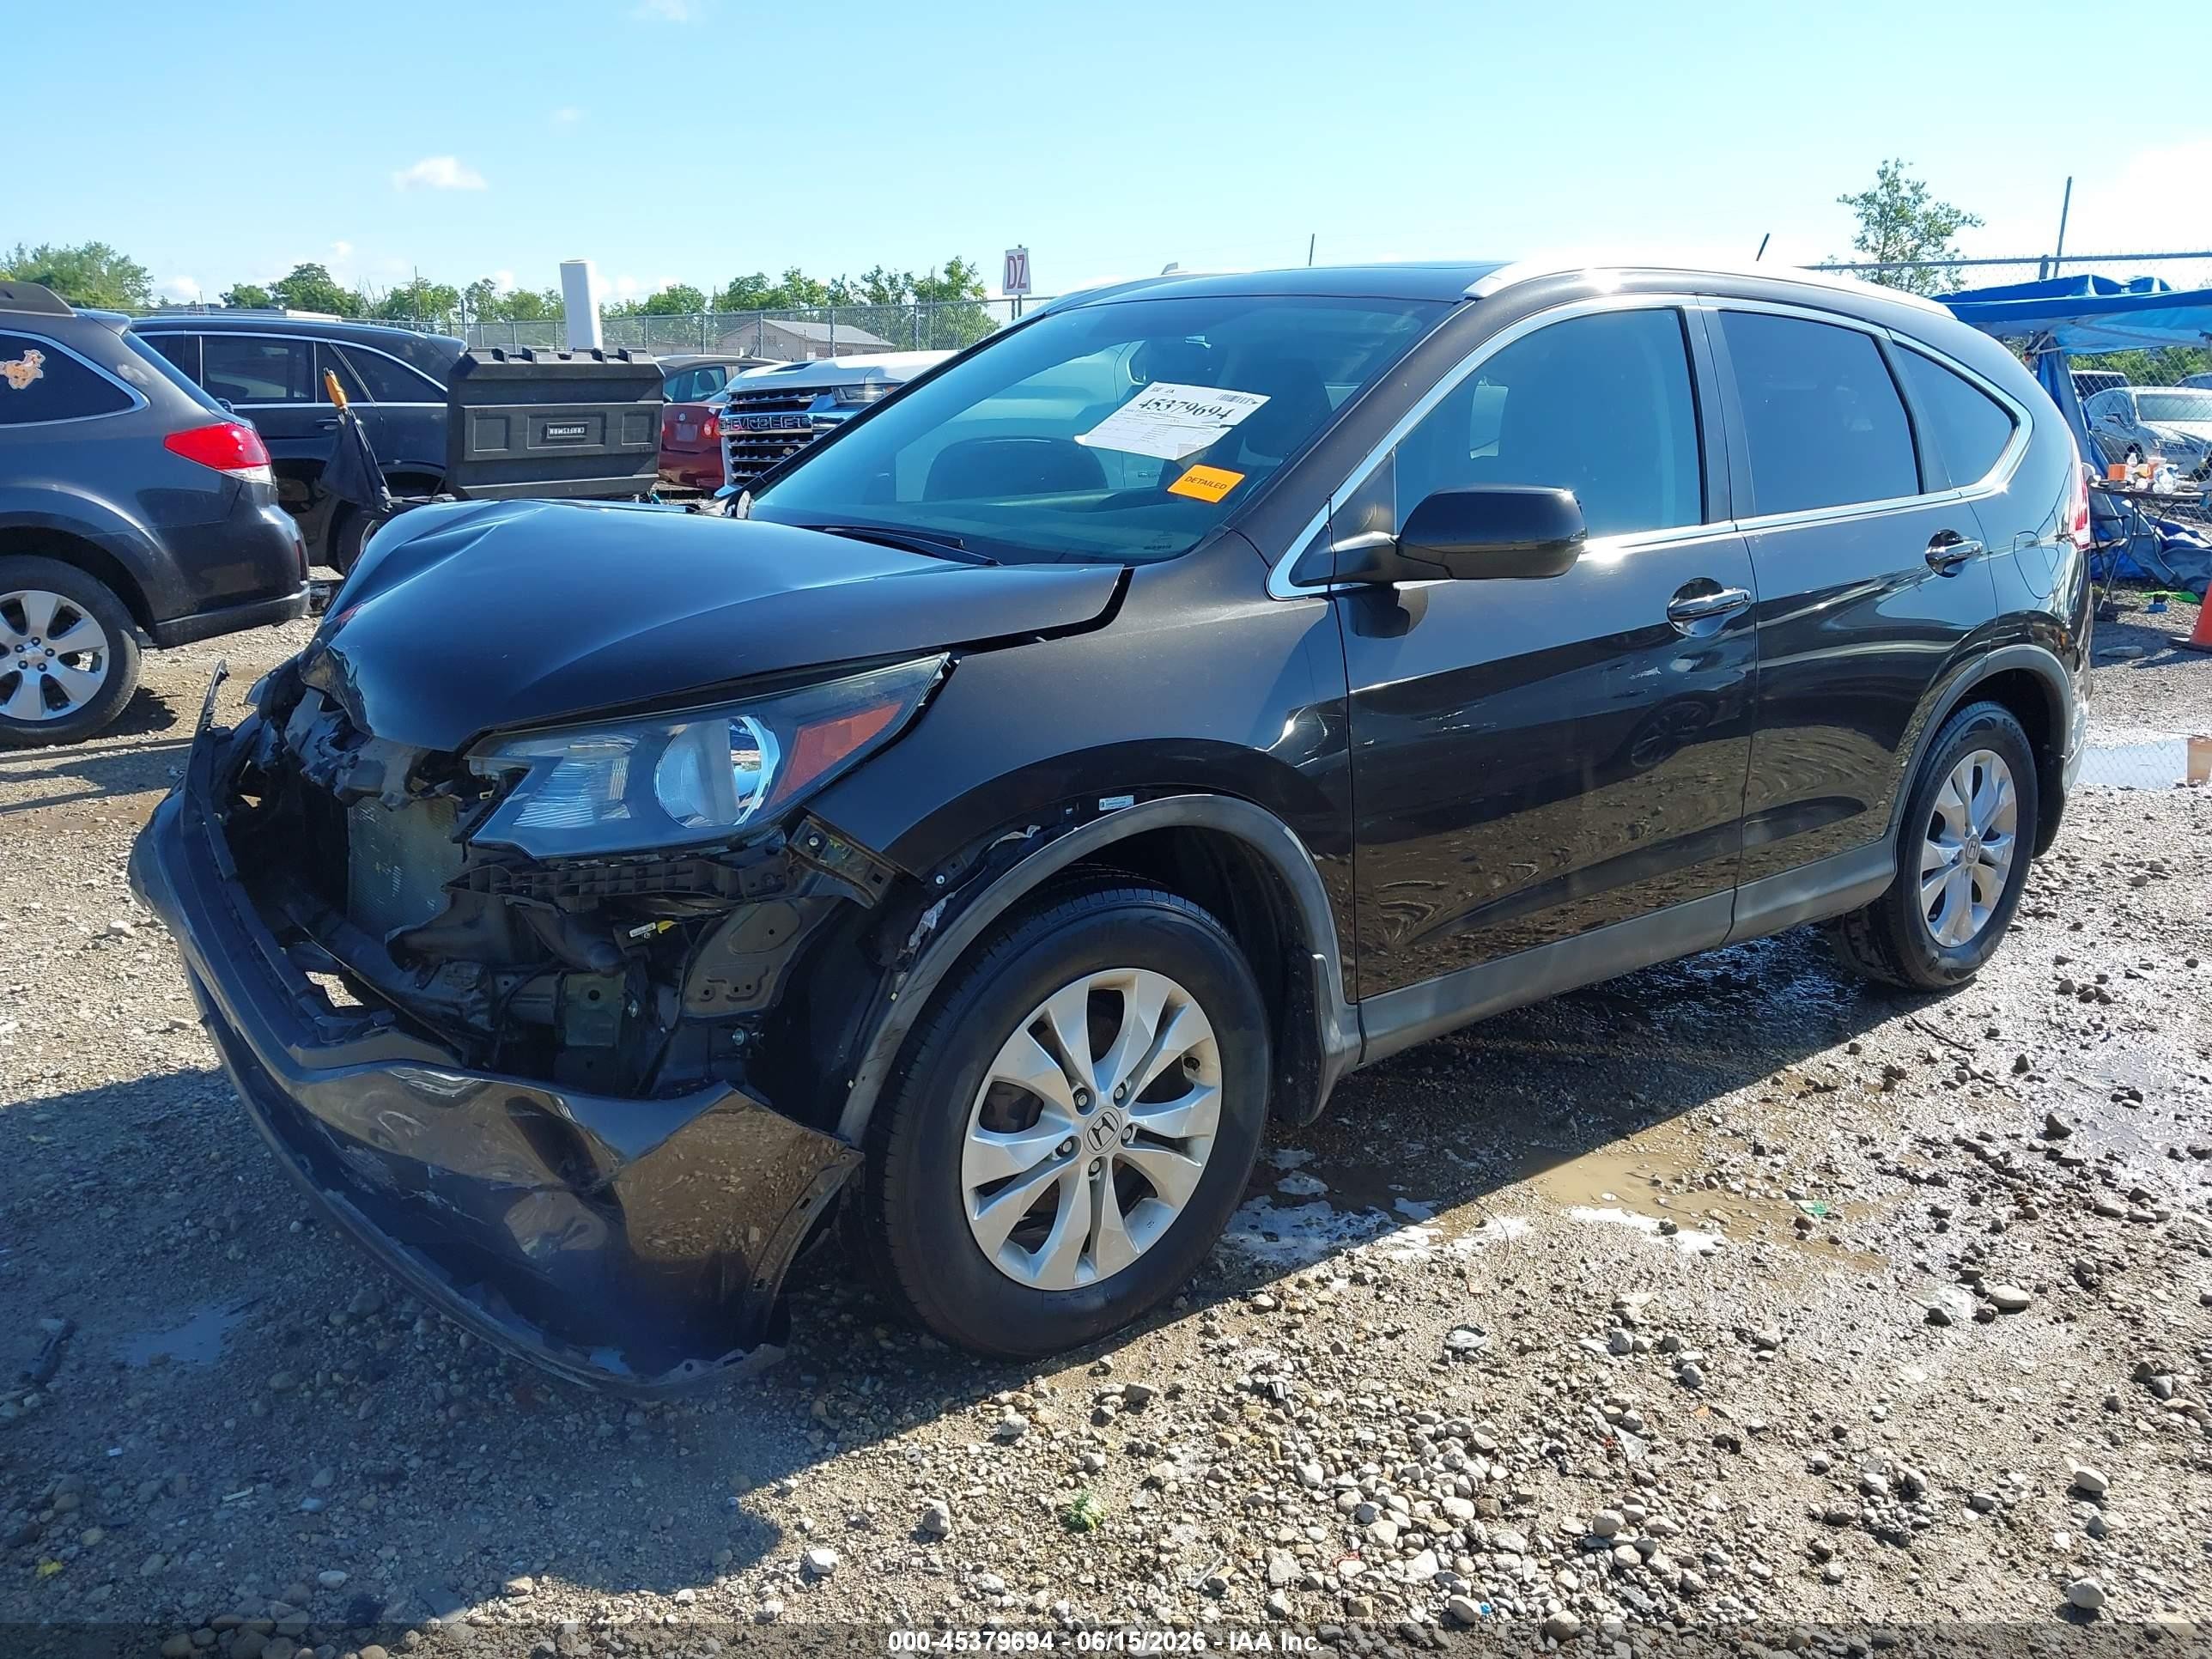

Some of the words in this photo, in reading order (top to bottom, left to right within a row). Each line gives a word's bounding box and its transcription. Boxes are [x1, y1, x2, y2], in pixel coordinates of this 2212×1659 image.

[1006, 254, 1027, 289] DZ
[1139, 398, 1236, 420] 45379694
[720, 416, 811, 430] CHEVROLET
[1184, 476, 1228, 490] DETAILED
